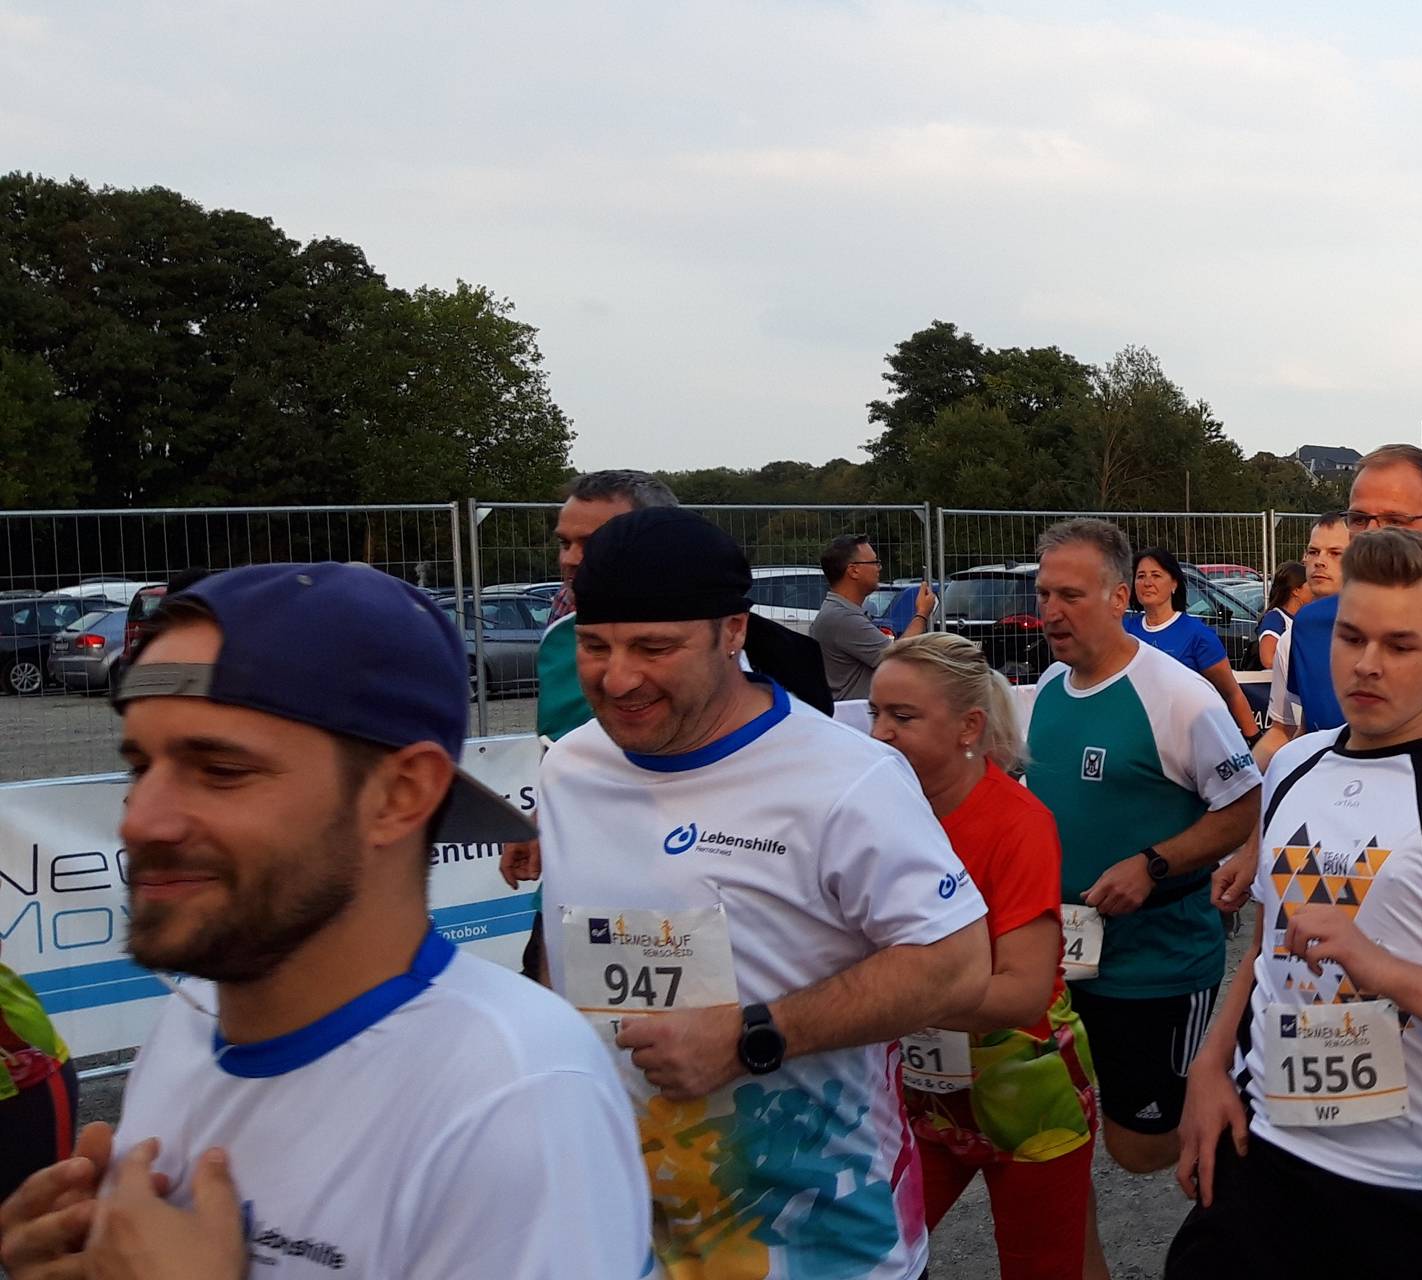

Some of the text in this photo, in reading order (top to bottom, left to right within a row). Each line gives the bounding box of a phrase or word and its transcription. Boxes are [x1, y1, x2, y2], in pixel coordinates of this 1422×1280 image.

[699, 830, 787, 855] Lebenshilfe
[1323, 850, 1350, 863] TEAM
[1323, 861, 1348, 877] RUN
[612, 933, 692, 948] FIRMENLAUF
[604, 963, 683, 1008] 947
[1280, 1052, 1378, 1094] 1556
[1314, 1106, 1340, 1120] WP
